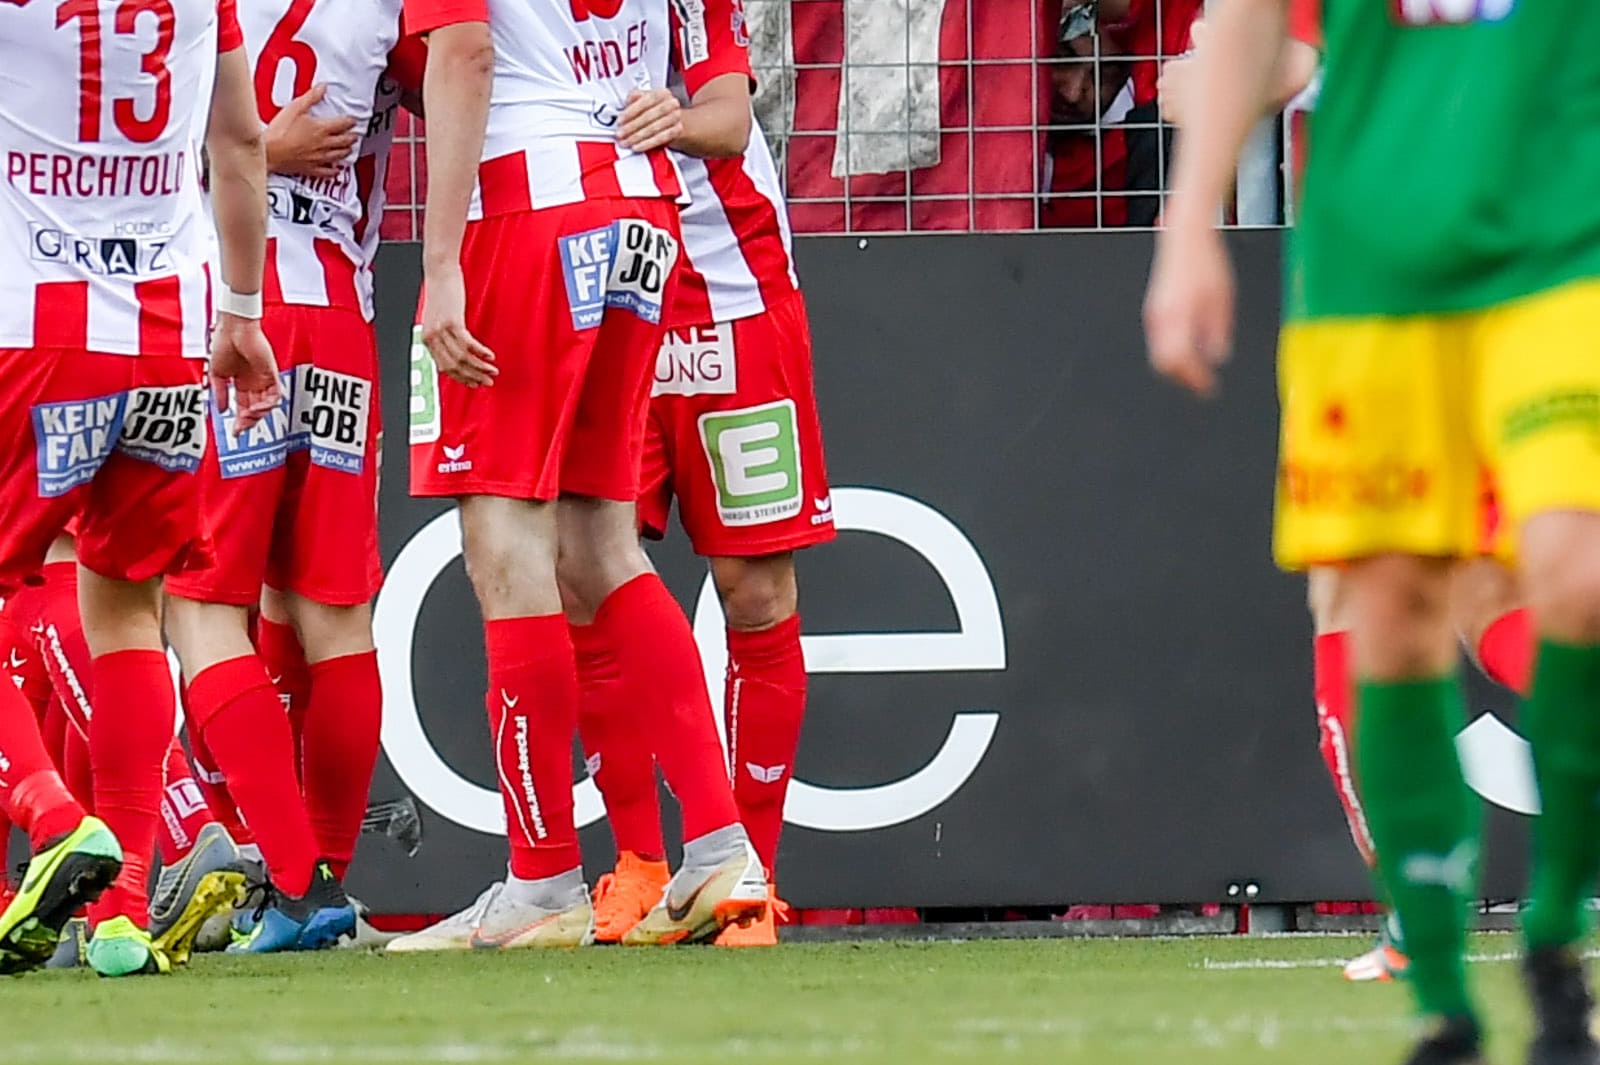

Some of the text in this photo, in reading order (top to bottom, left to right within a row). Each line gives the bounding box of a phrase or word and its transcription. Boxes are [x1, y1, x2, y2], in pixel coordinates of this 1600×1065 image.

[34, 228, 168, 273] GRAZ
[619, 252, 661, 294] JO
[39, 398, 118, 435] KEIN
[46, 423, 111, 470] FAN
[717, 420, 790, 497] E
